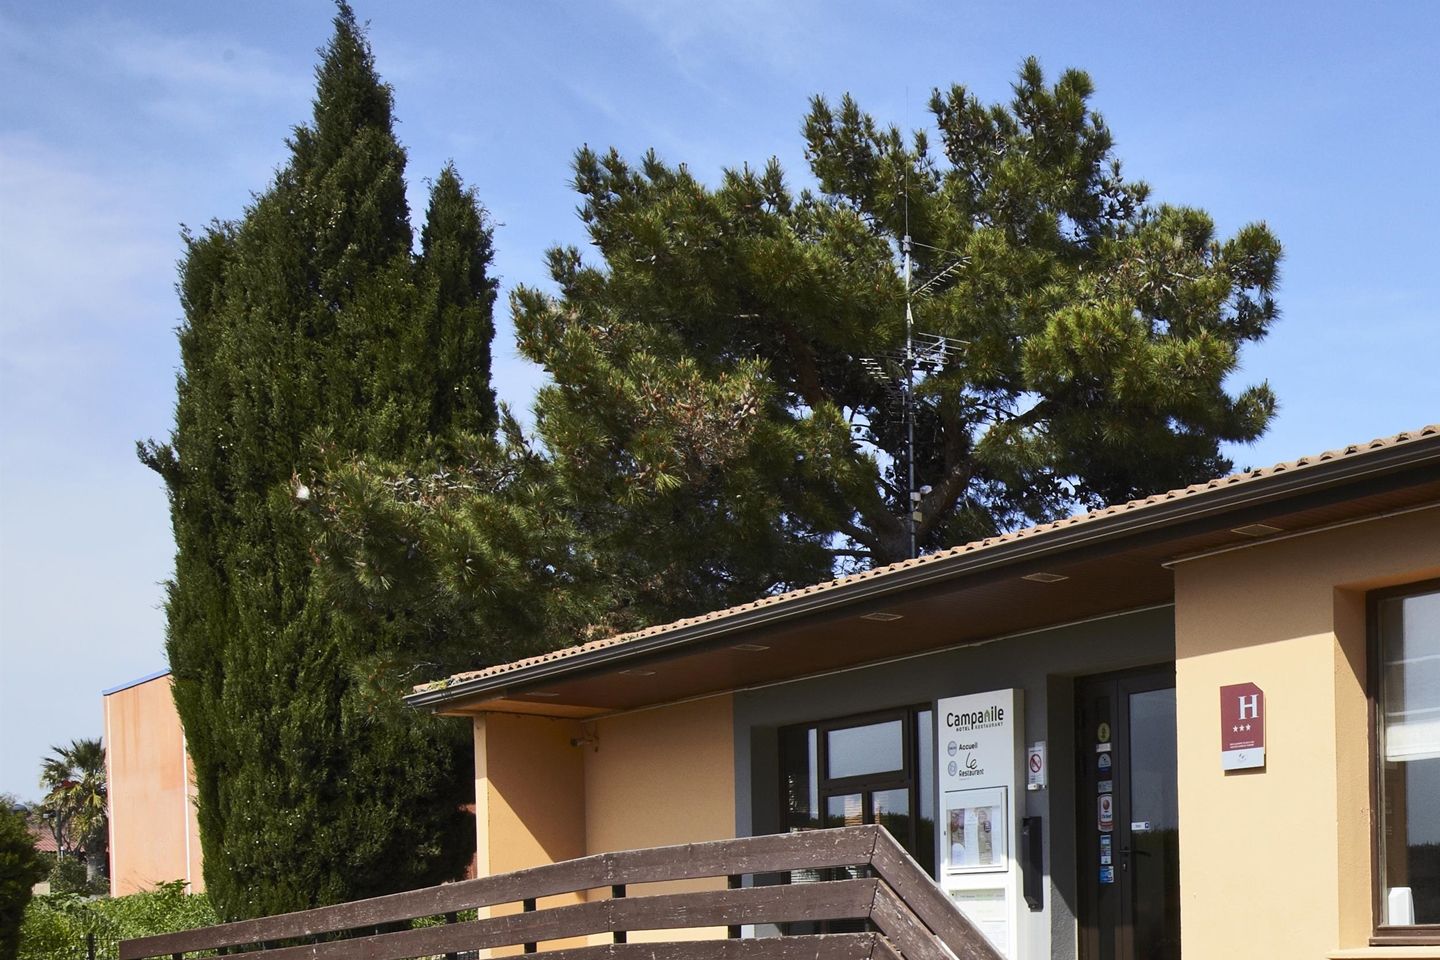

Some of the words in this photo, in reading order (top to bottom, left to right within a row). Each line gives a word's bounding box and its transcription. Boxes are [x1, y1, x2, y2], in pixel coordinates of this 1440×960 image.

[1238, 694, 1259, 720] H
[946, 705, 1004, 730] Campanile
[959, 742, 978, 750] Accueil
[959, 769, 984, 777] Restaurant
